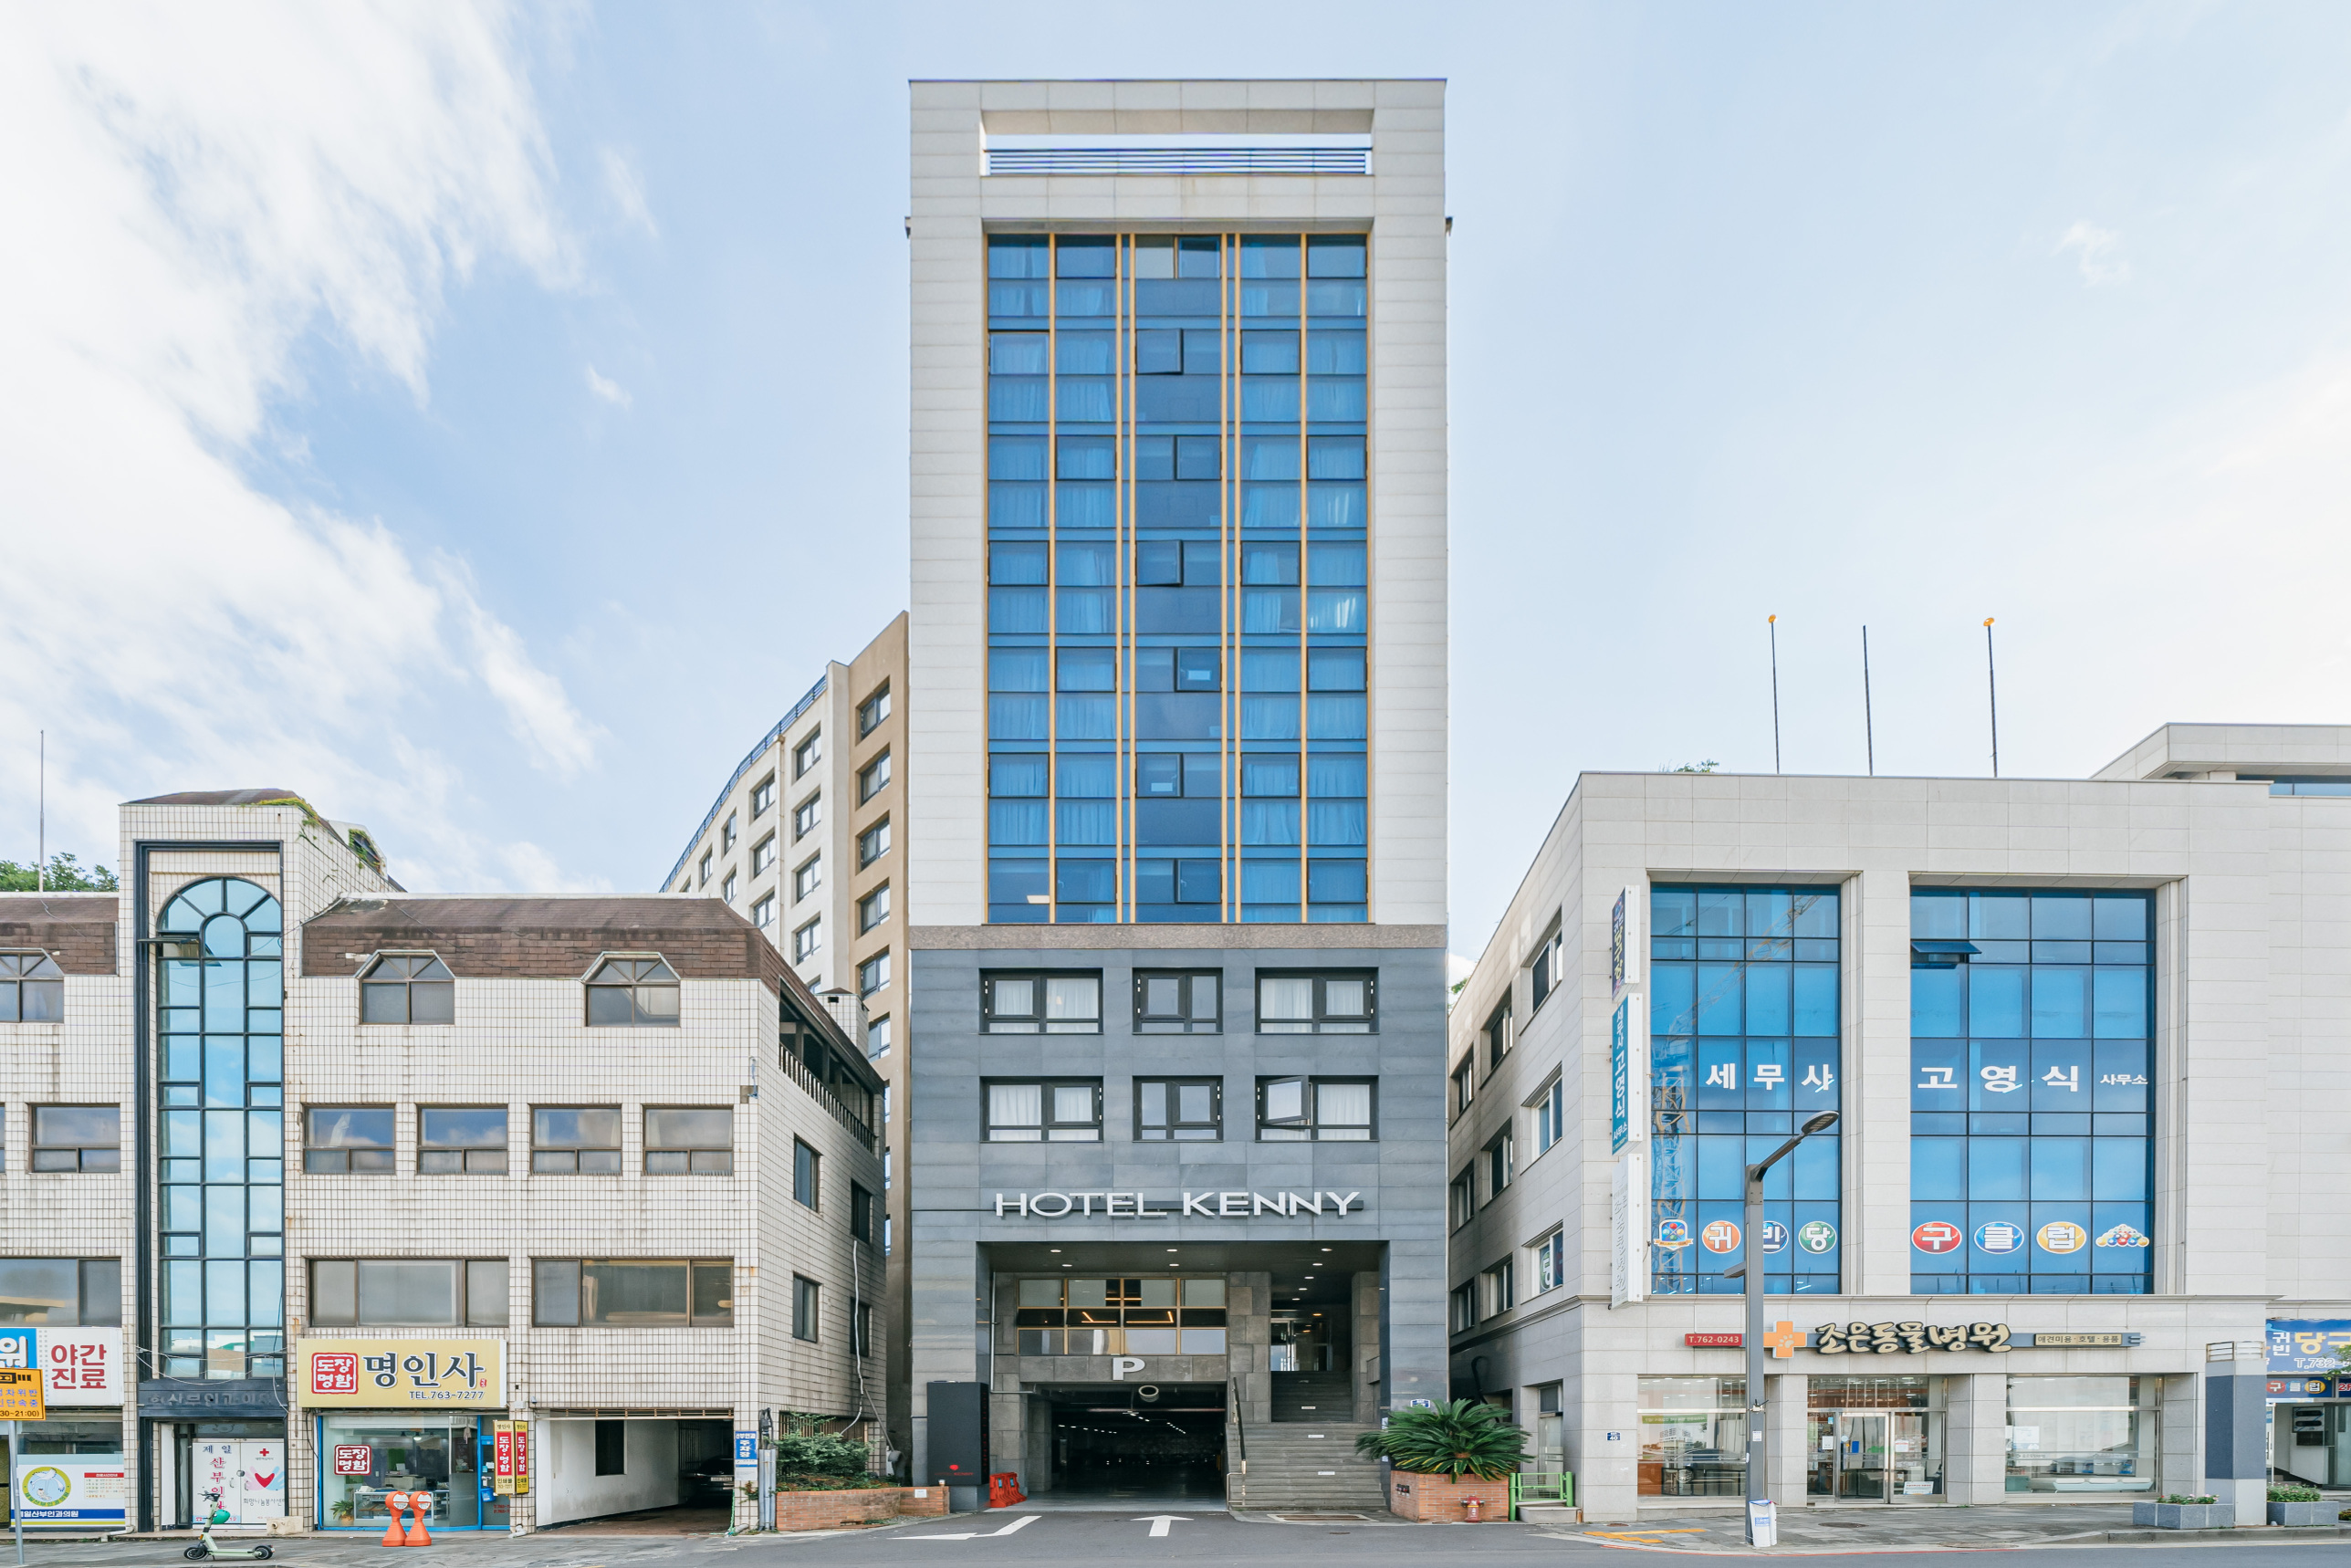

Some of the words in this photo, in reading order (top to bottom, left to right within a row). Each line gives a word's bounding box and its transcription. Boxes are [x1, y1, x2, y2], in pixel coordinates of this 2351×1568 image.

[1614, 1050, 1625, 1119] 고영식
[1706, 1062, 1834, 1091] 세무사
[1917, 1065, 2079, 1092] 고영식
[2099, 1073, 2149, 1086] 사무소
[1613, 1121, 1628, 1141] 사무소
[996, 1192, 1167, 1218] HOTEL
[1183, 1191, 1361, 1217] KENNY
[1688, 1335, 1740, 1343] T.762-0243
[1815, 1322, 2013, 1354] 조은동물병원
[51, 1343, 107, 1366] 야간
[318, 1358, 352, 1374] 도장
[361, 1352, 486, 1389] 명인사
[1113, 1357, 1145, 1381] P
[51, 1367, 107, 1389] 진료
[318, 1374, 352, 1388] 명함
[409, 1391, 485, 1399] TEL.763-7277
[339, 1448, 367, 1459] 도장
[740, 1439, 750, 1458] 주차장
[339, 1459, 367, 1470] 명함
